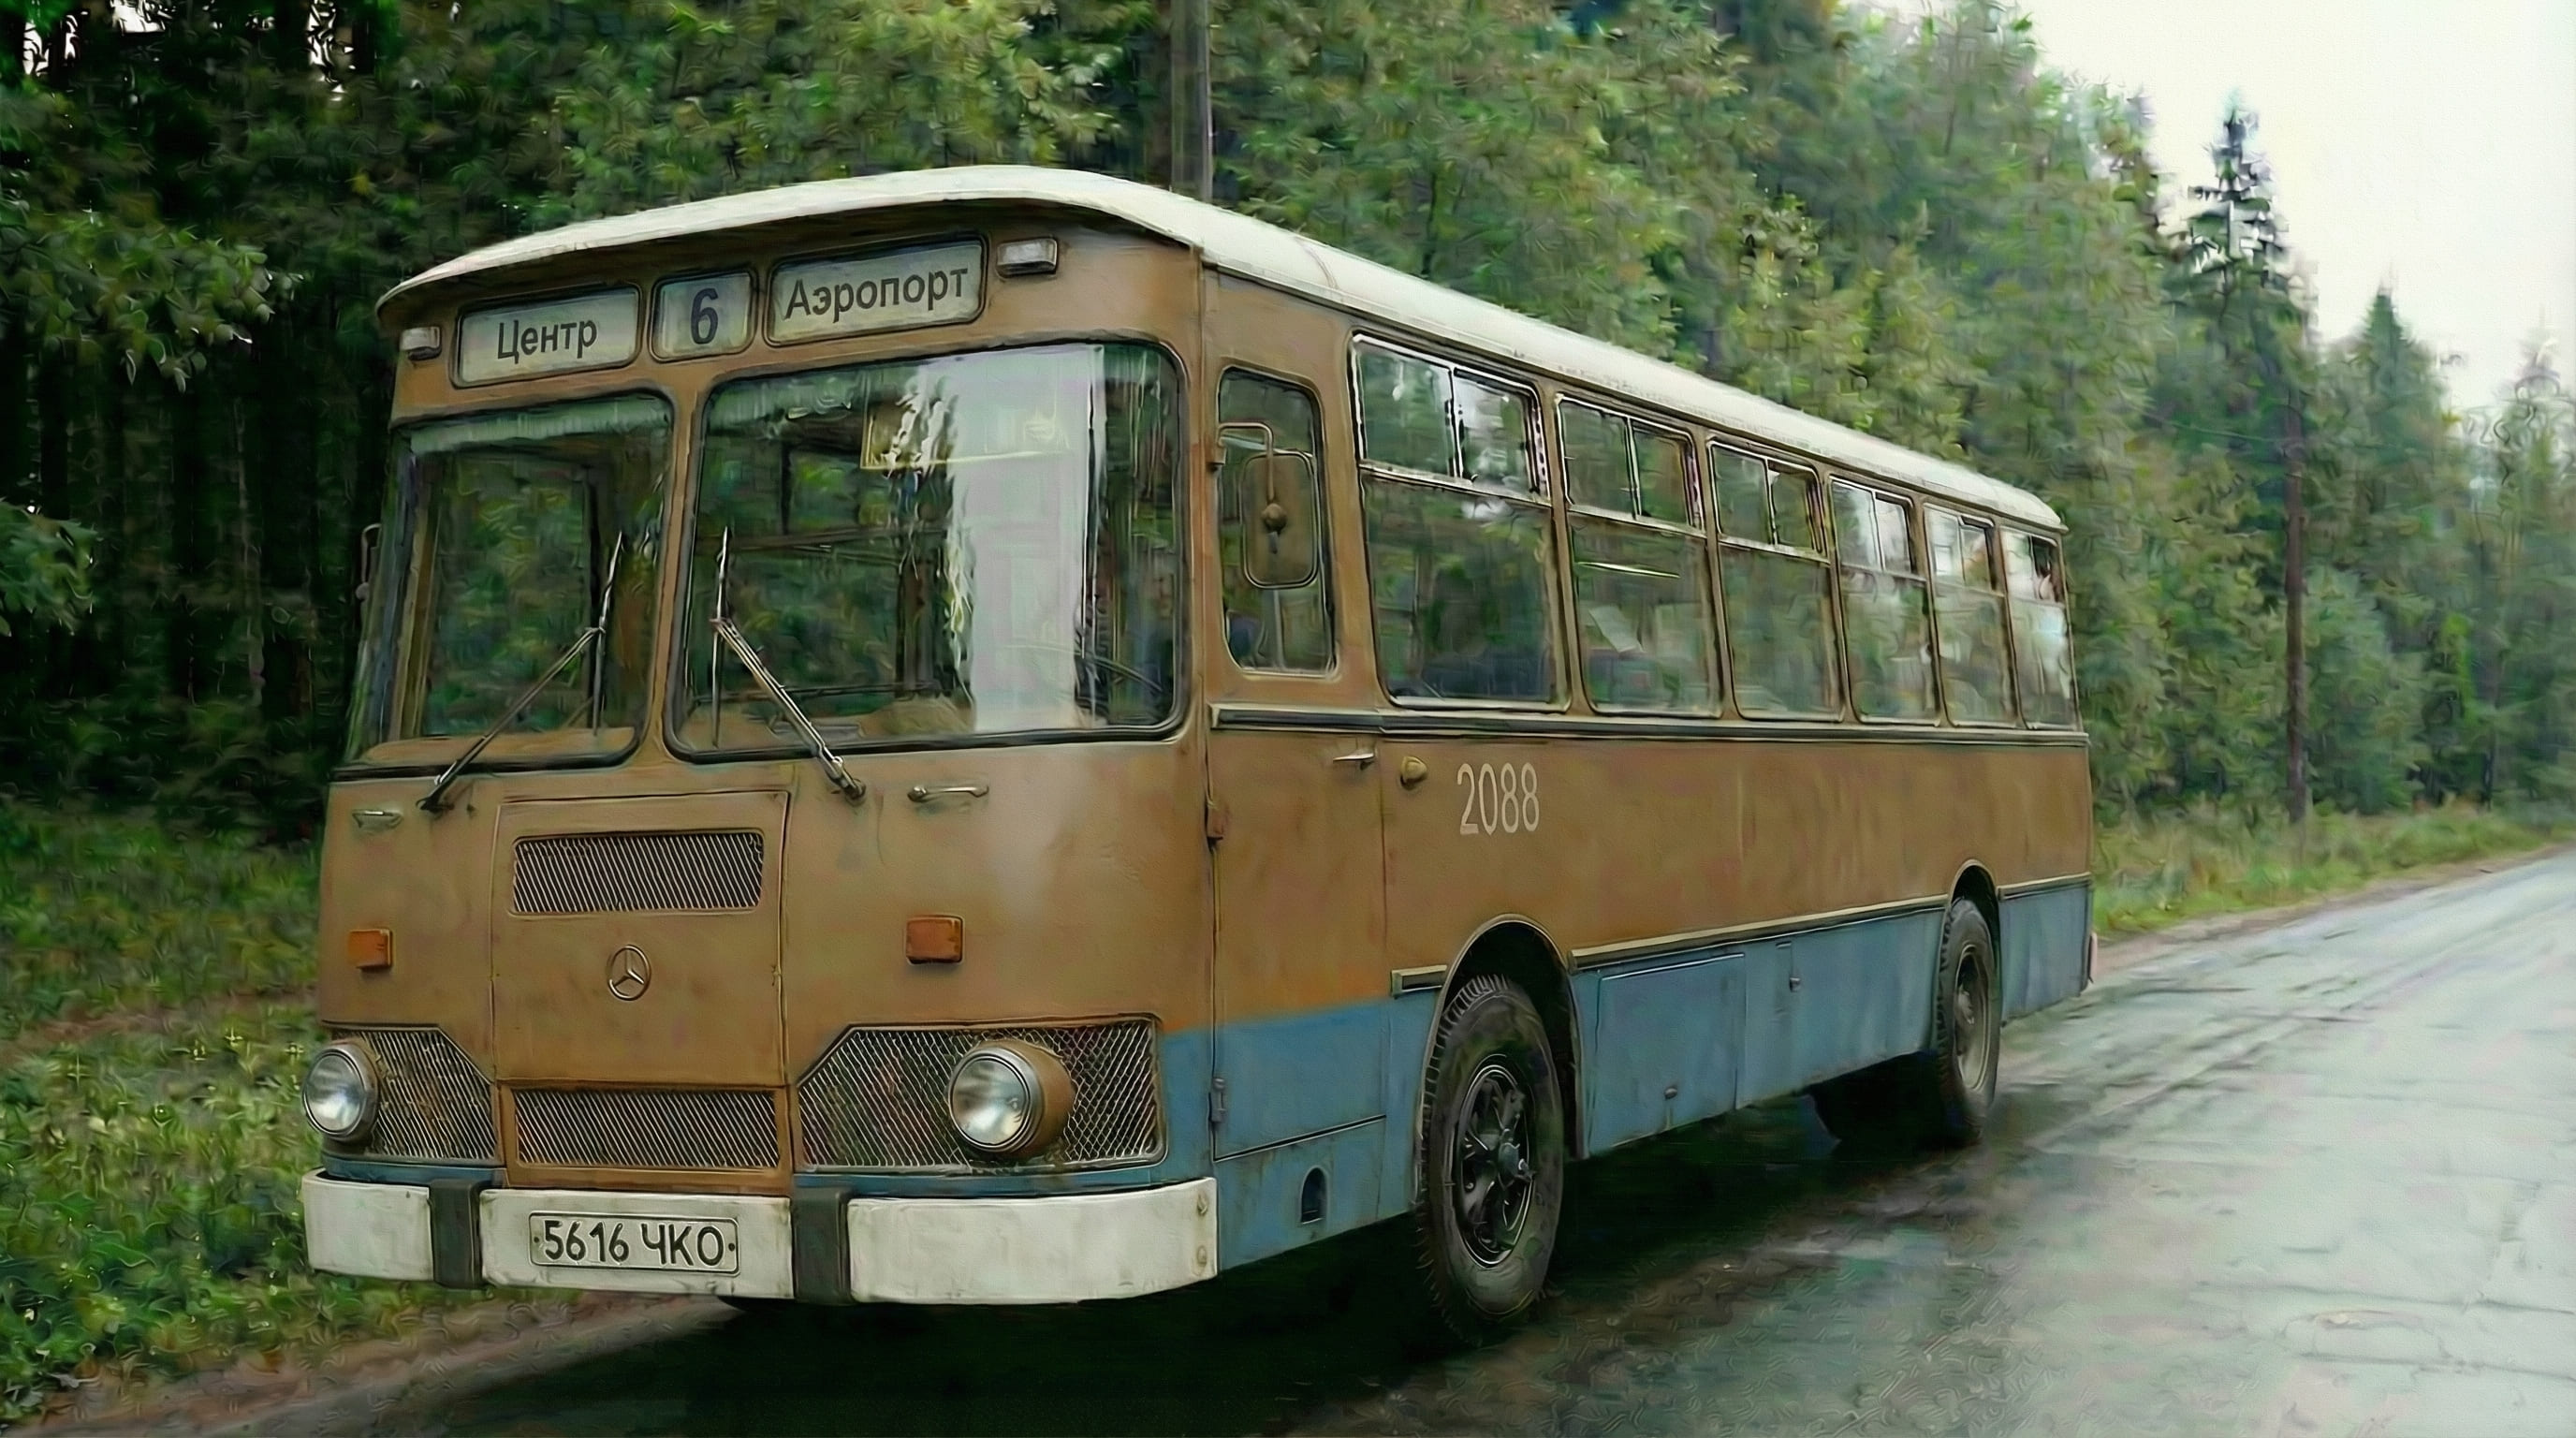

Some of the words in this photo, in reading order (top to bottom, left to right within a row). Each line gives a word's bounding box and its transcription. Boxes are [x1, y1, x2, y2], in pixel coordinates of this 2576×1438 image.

[690, 287, 720, 345] 6
[783, 264, 969, 322] Аэропорт
[495, 317, 598, 362] Центр
[1456, 762, 1540, 835] 2088
[544, 1220, 630, 1262] 5616
[640, 1223, 724, 1267] ЧКО
